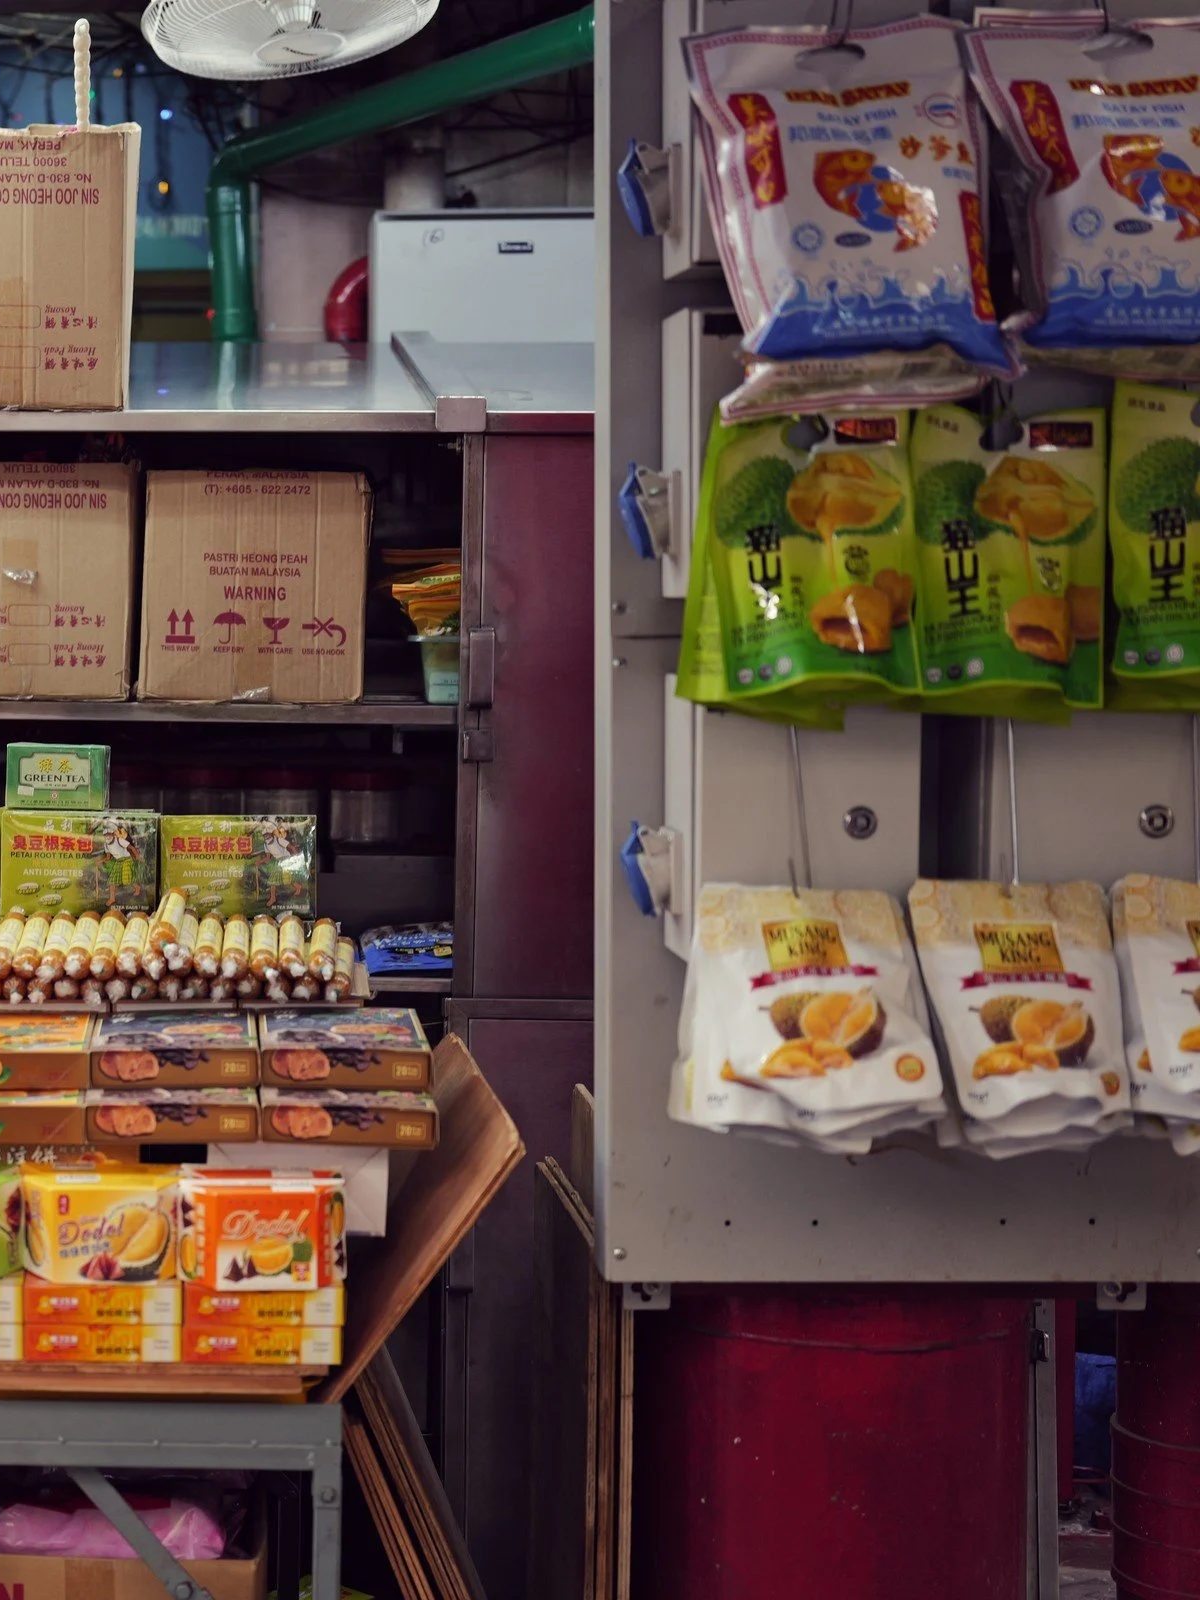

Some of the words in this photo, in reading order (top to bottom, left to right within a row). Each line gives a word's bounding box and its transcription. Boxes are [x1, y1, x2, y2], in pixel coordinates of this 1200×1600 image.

[1128, 75, 1200, 97] SATAY
[840, 81, 911, 107] SATAY
[1152, 103, 1186, 113] FISH
[865, 106, 897, 121] FISH
[17, 140, 61, 150] PERAK,
[33, 157, 67, 166] 36000
[37, 173, 70, 183] 830-D
[73, 174, 91, 183] No.
[13, 188, 53, 204] HEONG
[56, 188, 79, 204] JOO
[81, 188, 99, 204] SIN
[45, 305, 77, 315] Kosong
[44, 346, 65, 356] Peah
[67, 347, 96, 356] Heong
[3, 463, 40, 473] TELUK
[43, 463, 76, 473] 36000
[7, 479, 44, 488] JALAN
[47, 479, 79, 488] 830-D
[81, 480, 100, 488] No.
[225, 485, 252, 495] +605
[261, 485, 281, 495] 622
[284, 485, 311, 495] 2472
[24, 493, 62, 509] HEONG
[64, 493, 87, 509] JOO
[89, 493, 107, 509] SIN
[203, 552, 239, 563] PASTRI
[241, 553, 278, 564] HEONG
[280, 554, 308, 564] PEAH
[209, 567, 249, 576] BUATAN
[251, 567, 301, 577] MALAYSIA
[224, 586, 287, 601] WARNING
[54, 604, 85, 614] Kosong
[53, 643, 74, 653] Peah
[77, 644, 104, 653] Heong
[160, 644, 175, 652] THIS
[257, 646, 275, 654] WITH
[326, 648, 345, 656] HOOK
[24, 774, 62, 783] GREEN
[65, 774, 86, 783] TEA
[11, 835, 93, 853] 臭豆根茶包
[170, 835, 253, 853] 臭豆根茶包
[10, 851, 33, 859] PETAI
[57, 852, 74, 860] TEA
[169, 852, 192, 860] PETAI
[193, 852, 217, 860] ROOT
[217, 852, 234, 860] TEA
[23, 869, 43, 877] ANTI
[44, 869, 83, 877] DIABETES
[182, 870, 202, 878] ANTI
[203, 870, 244, 878] DIABETES
[768, 927, 837, 946] MUSANG
[980, 930, 1051, 948] MUSANG
[786, 941, 828, 960] KING
[1000, 947, 1042, 965] KING
[58, 1213, 124, 1245] Dodol
[223, 1208, 311, 1242] Dodol
